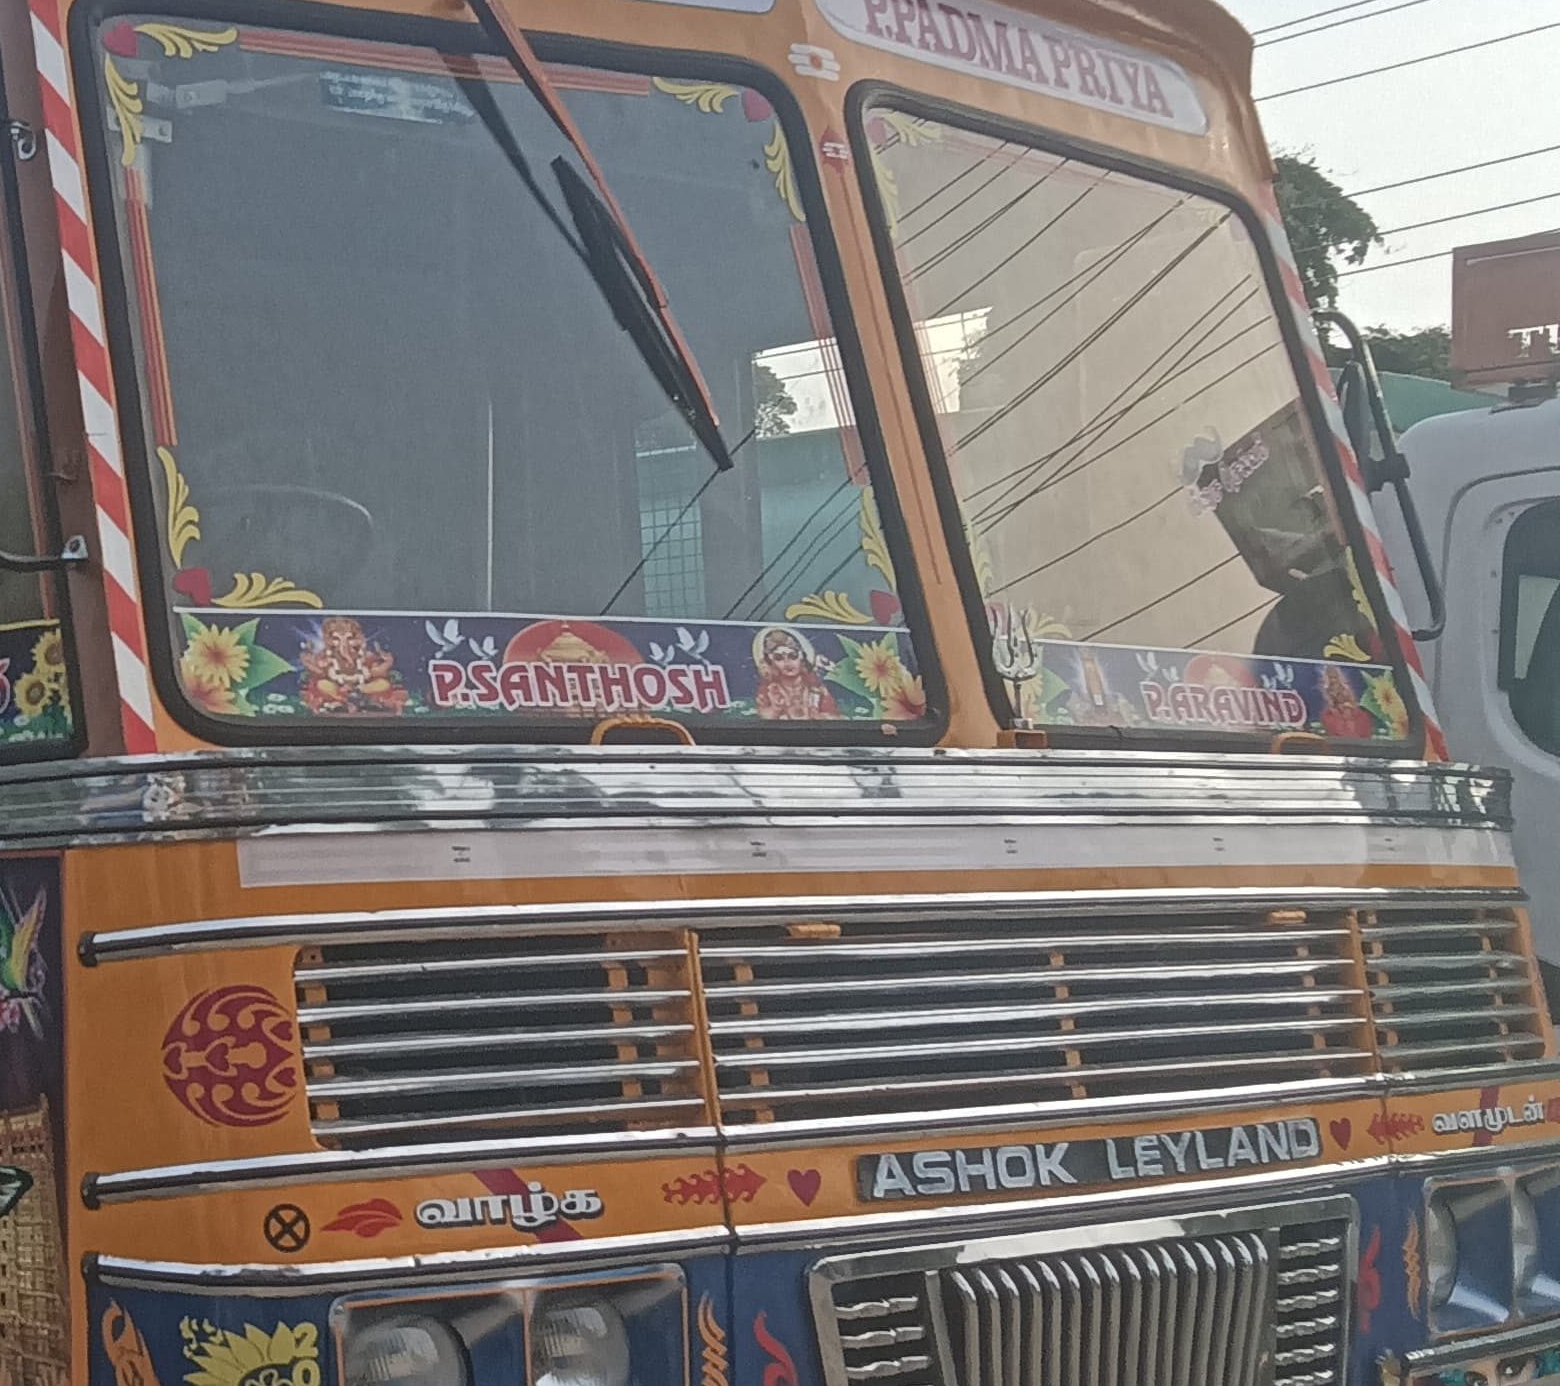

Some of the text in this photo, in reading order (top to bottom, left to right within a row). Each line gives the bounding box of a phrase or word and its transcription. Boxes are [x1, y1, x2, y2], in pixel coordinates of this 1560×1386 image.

[429, 661, 730, 711] P.SANTHOSH
[1140, 681, 1307, 728] P.ARAVIND
[1430, 1093, 1545, 1136] வளமுடன்
[873, 1117, 1320, 1198] ASHOK LEYLAND
[413, 1180, 606, 1233] வாழ்க
